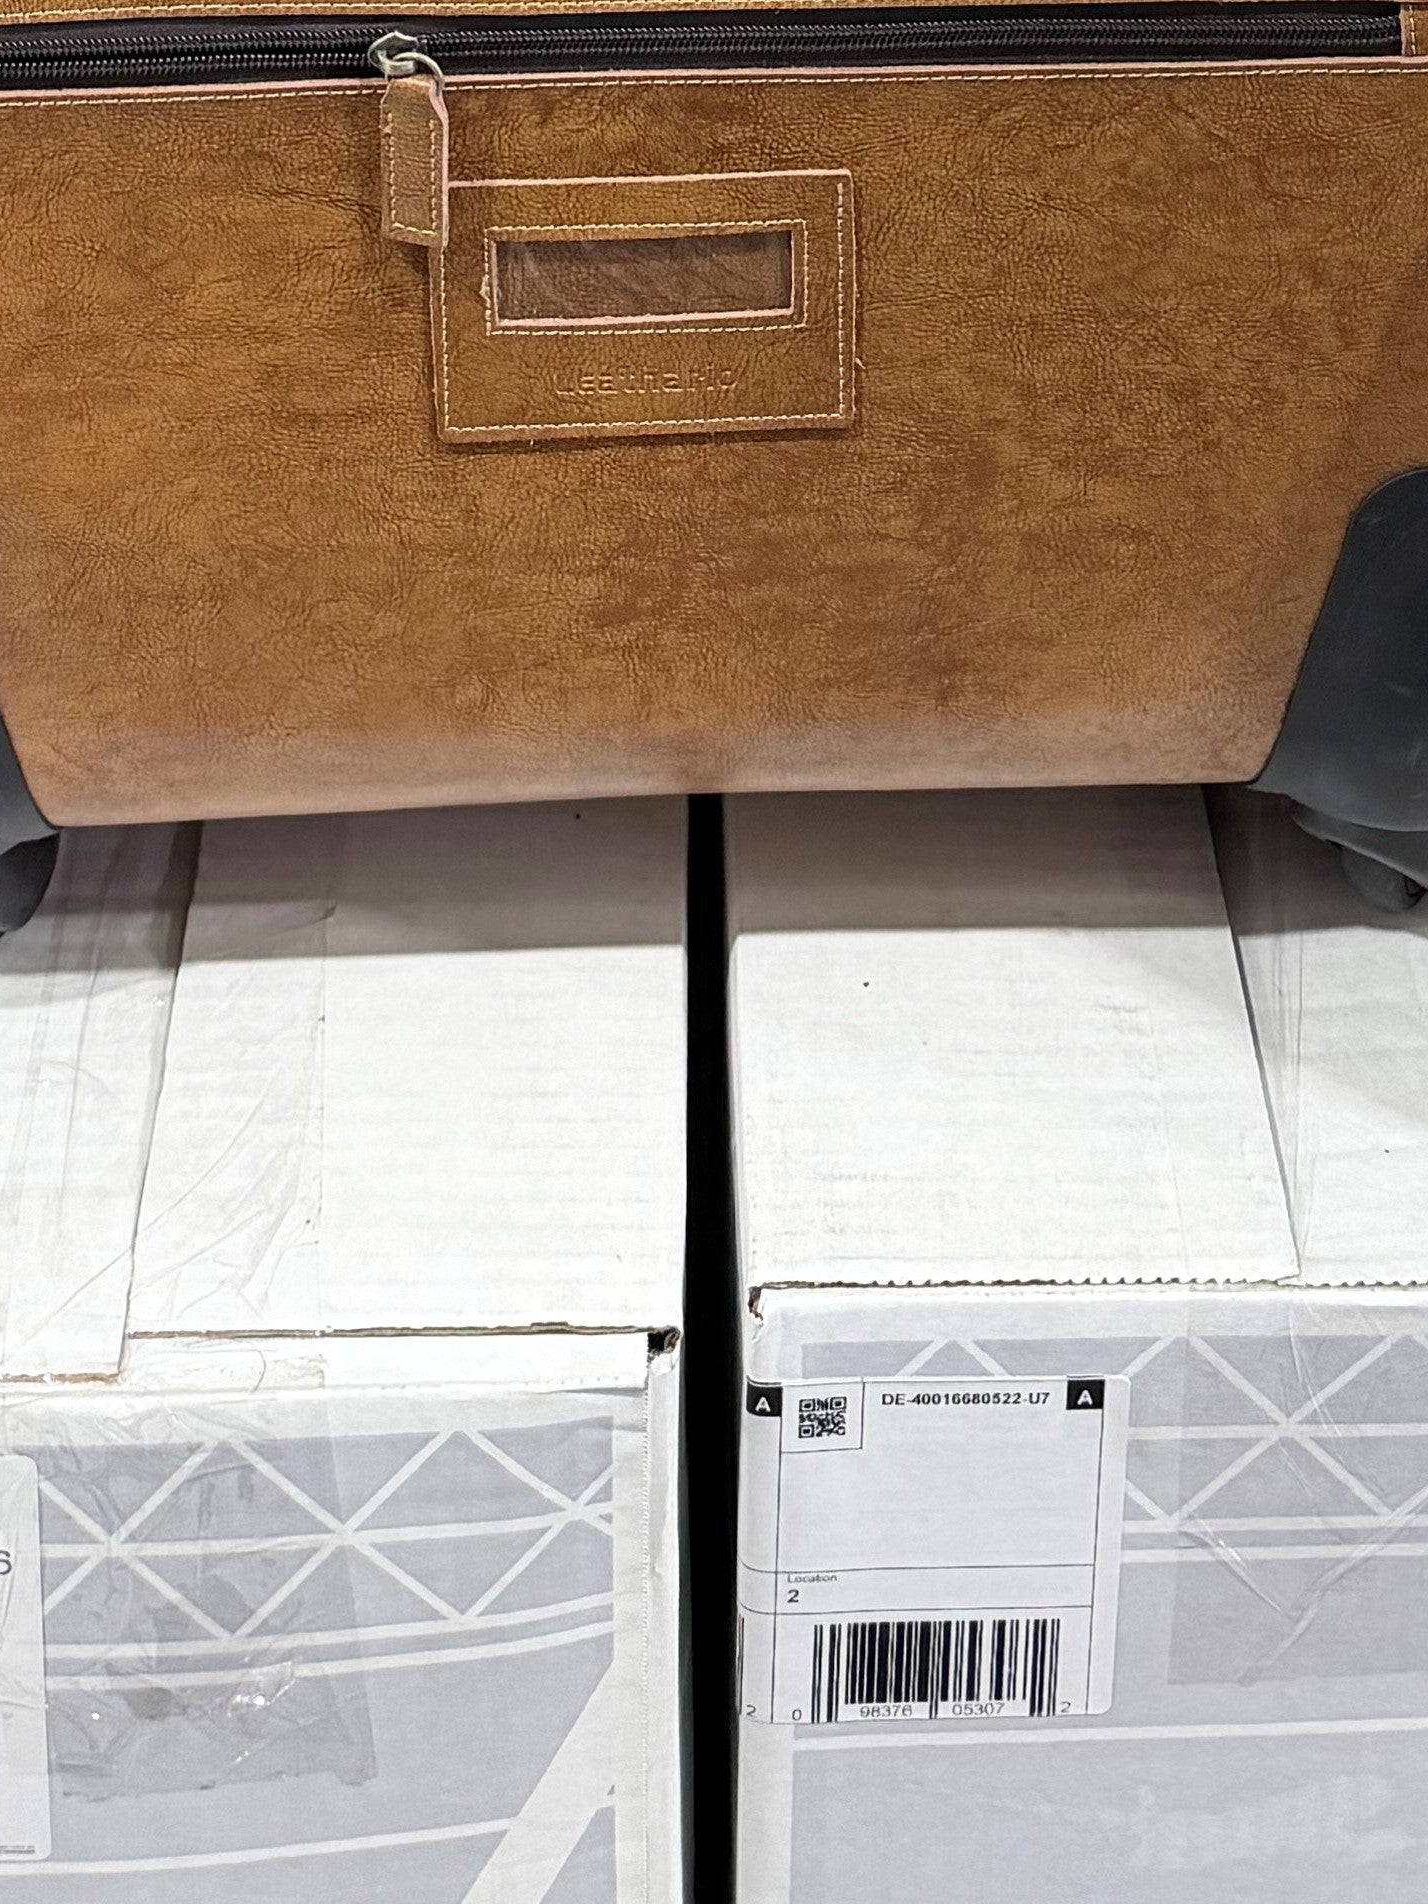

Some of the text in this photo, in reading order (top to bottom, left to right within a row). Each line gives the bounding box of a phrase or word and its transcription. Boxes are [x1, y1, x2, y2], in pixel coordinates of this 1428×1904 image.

[756, 1389, 1094, 1413] A DE-40016680522-U7 A
[787, 1572, 838, 1584] Location
[787, 1588, 800, 1604] 2
[746, 1700, 1071, 1721] 2 0 98376 05307 2
